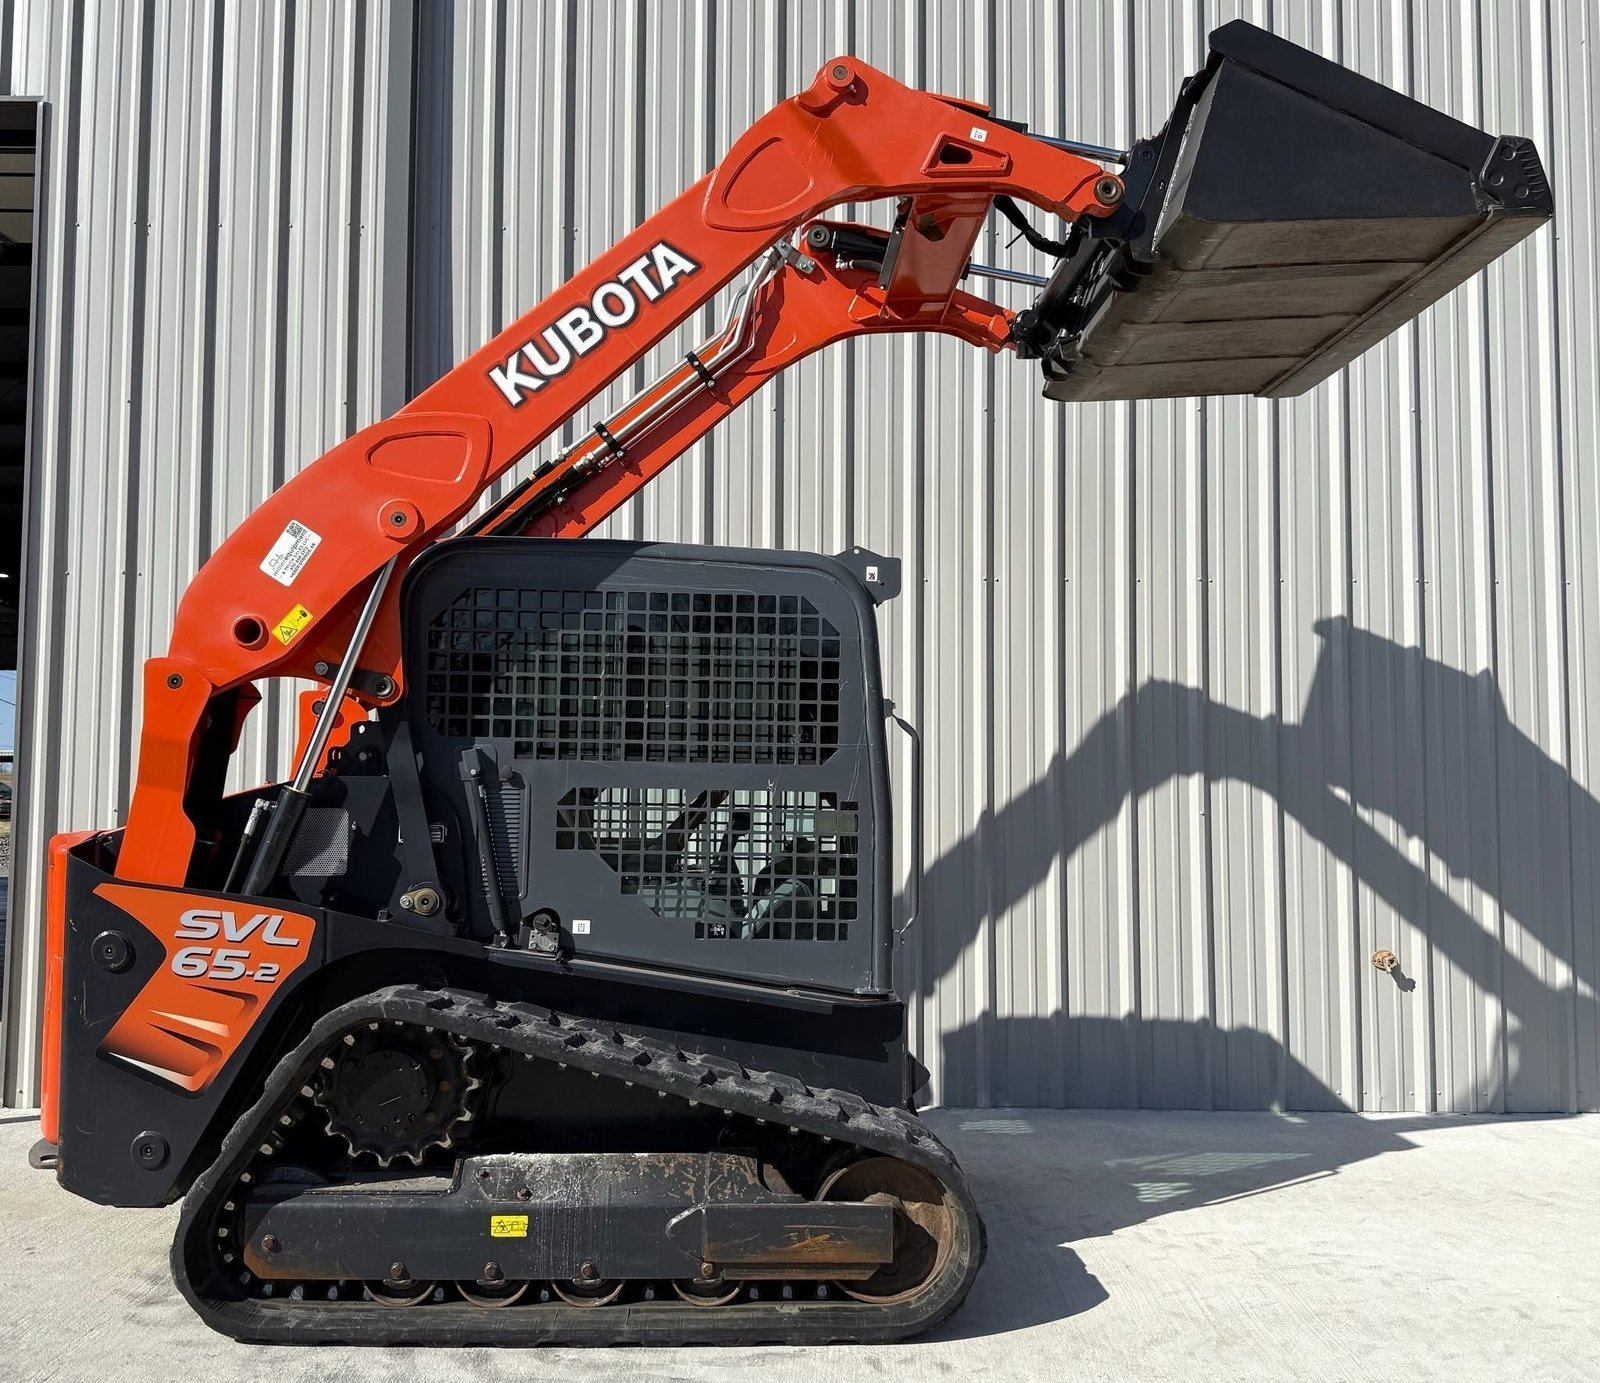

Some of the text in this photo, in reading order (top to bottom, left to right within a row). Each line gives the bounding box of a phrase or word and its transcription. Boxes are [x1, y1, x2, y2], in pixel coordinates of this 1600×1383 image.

[487, 242, 699, 407] KUBOTA
[174, 909, 300, 947] SVL
[171, 946, 280, 982] 65-2
